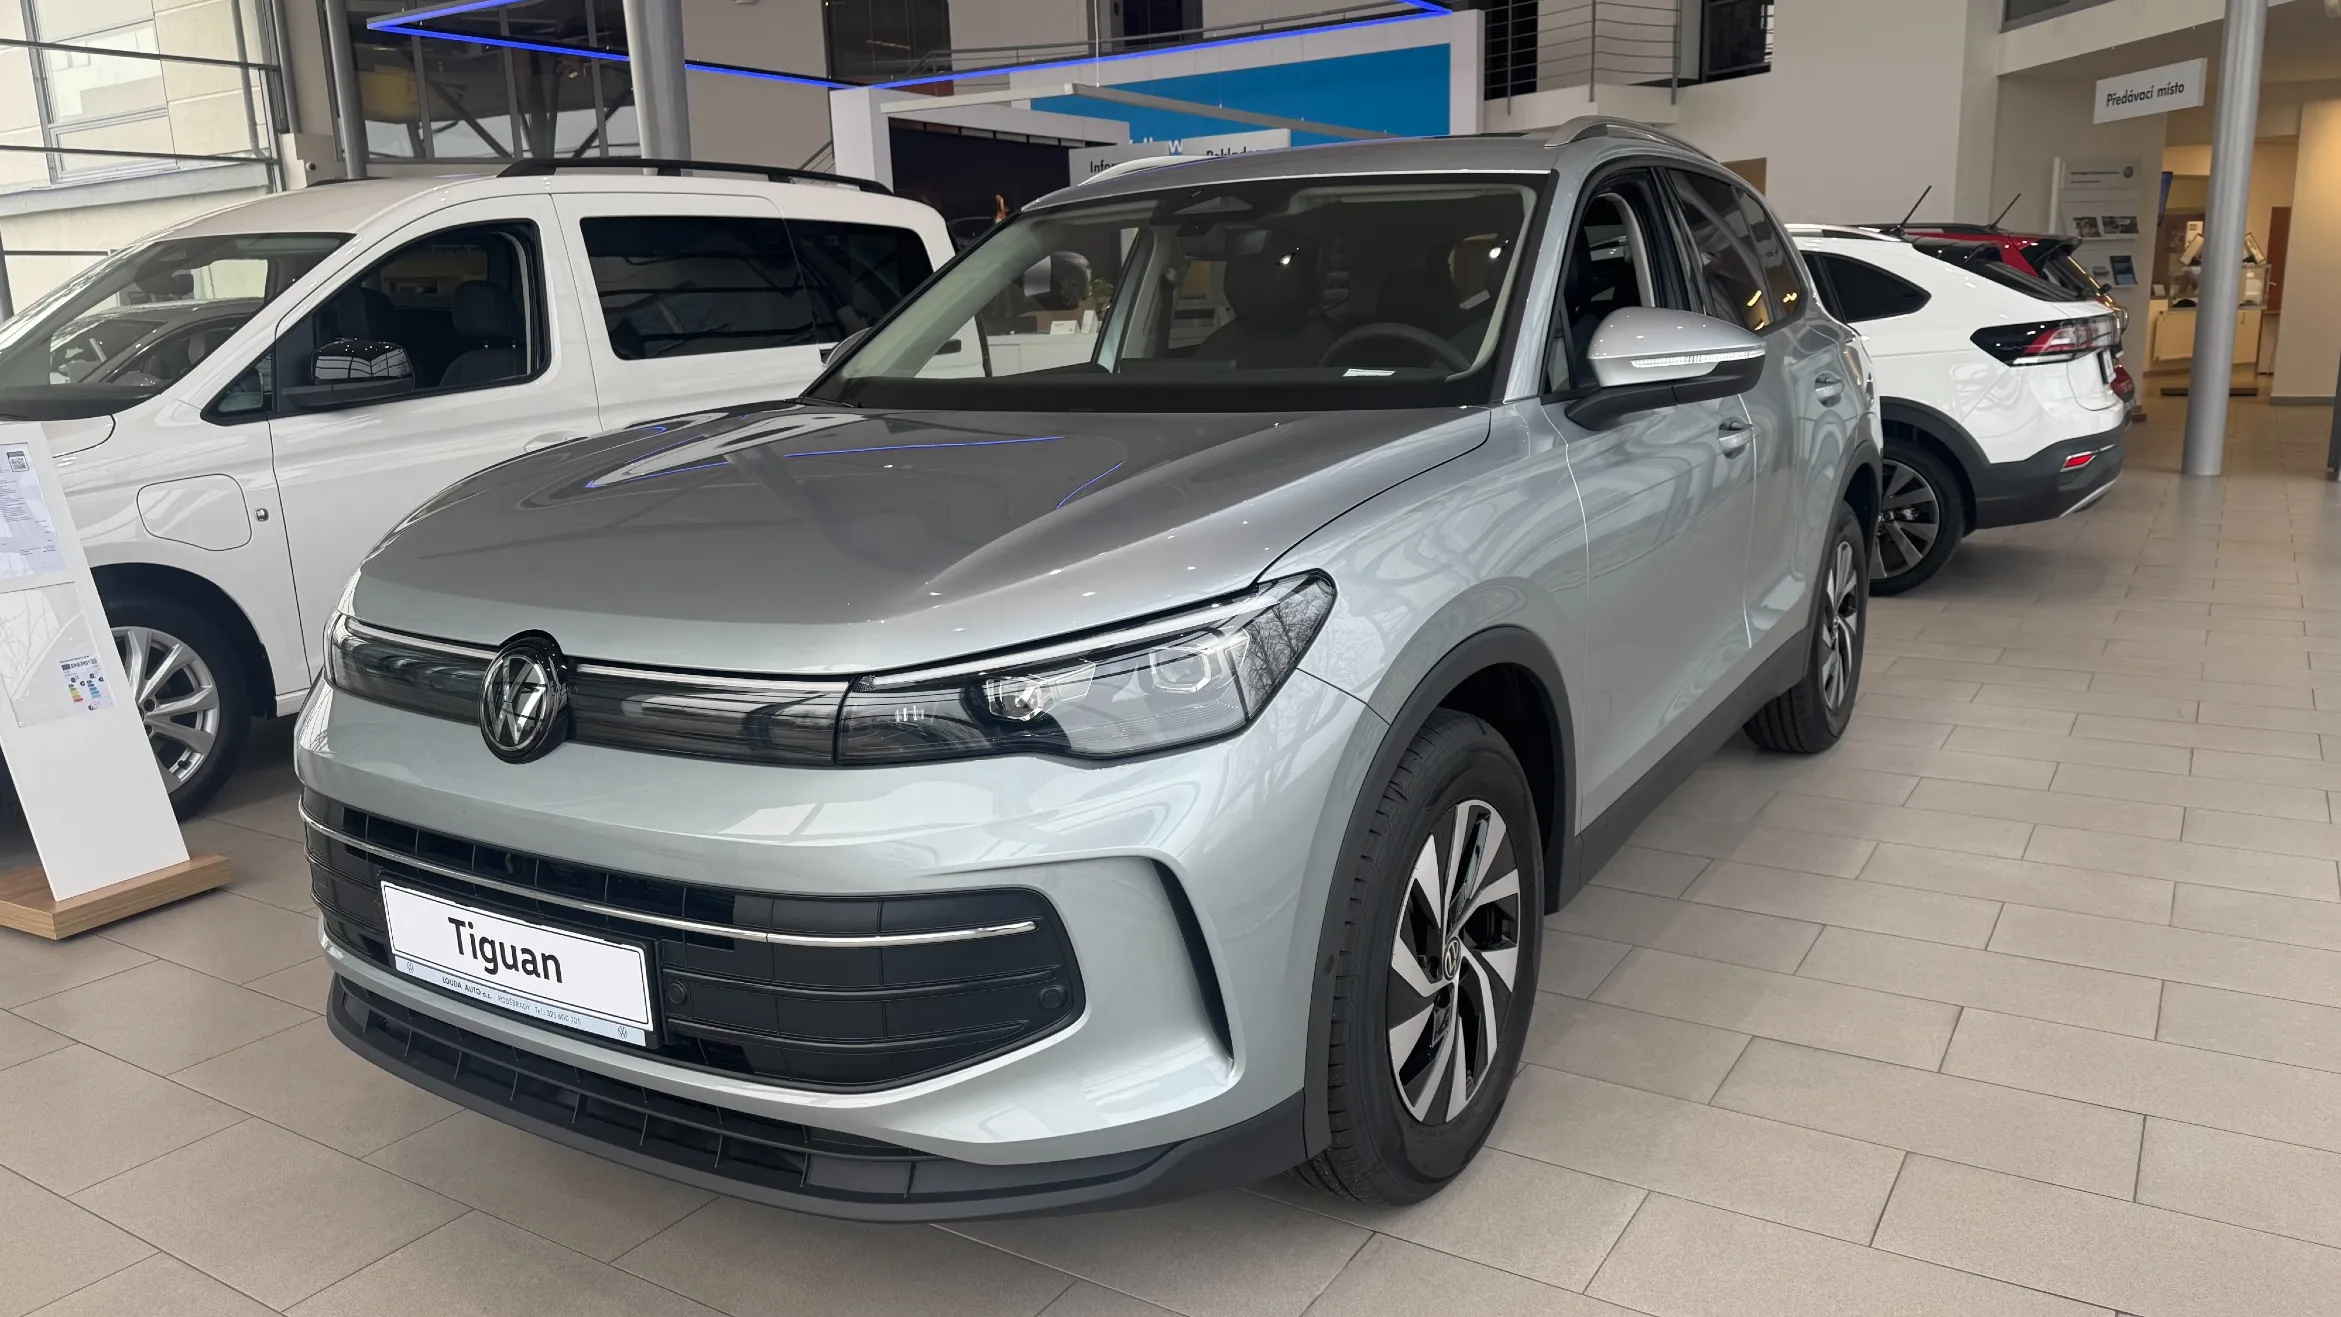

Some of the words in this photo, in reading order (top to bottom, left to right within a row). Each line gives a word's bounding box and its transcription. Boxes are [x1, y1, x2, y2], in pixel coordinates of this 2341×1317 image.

[2106, 85, 2155, 107] Předávací
[2157, 81, 2185, 98] místo
[448, 916, 563, 984] Tiguan
[442, 976, 462, 989] LOUDA
[465, 984, 481, 996] AUTO
